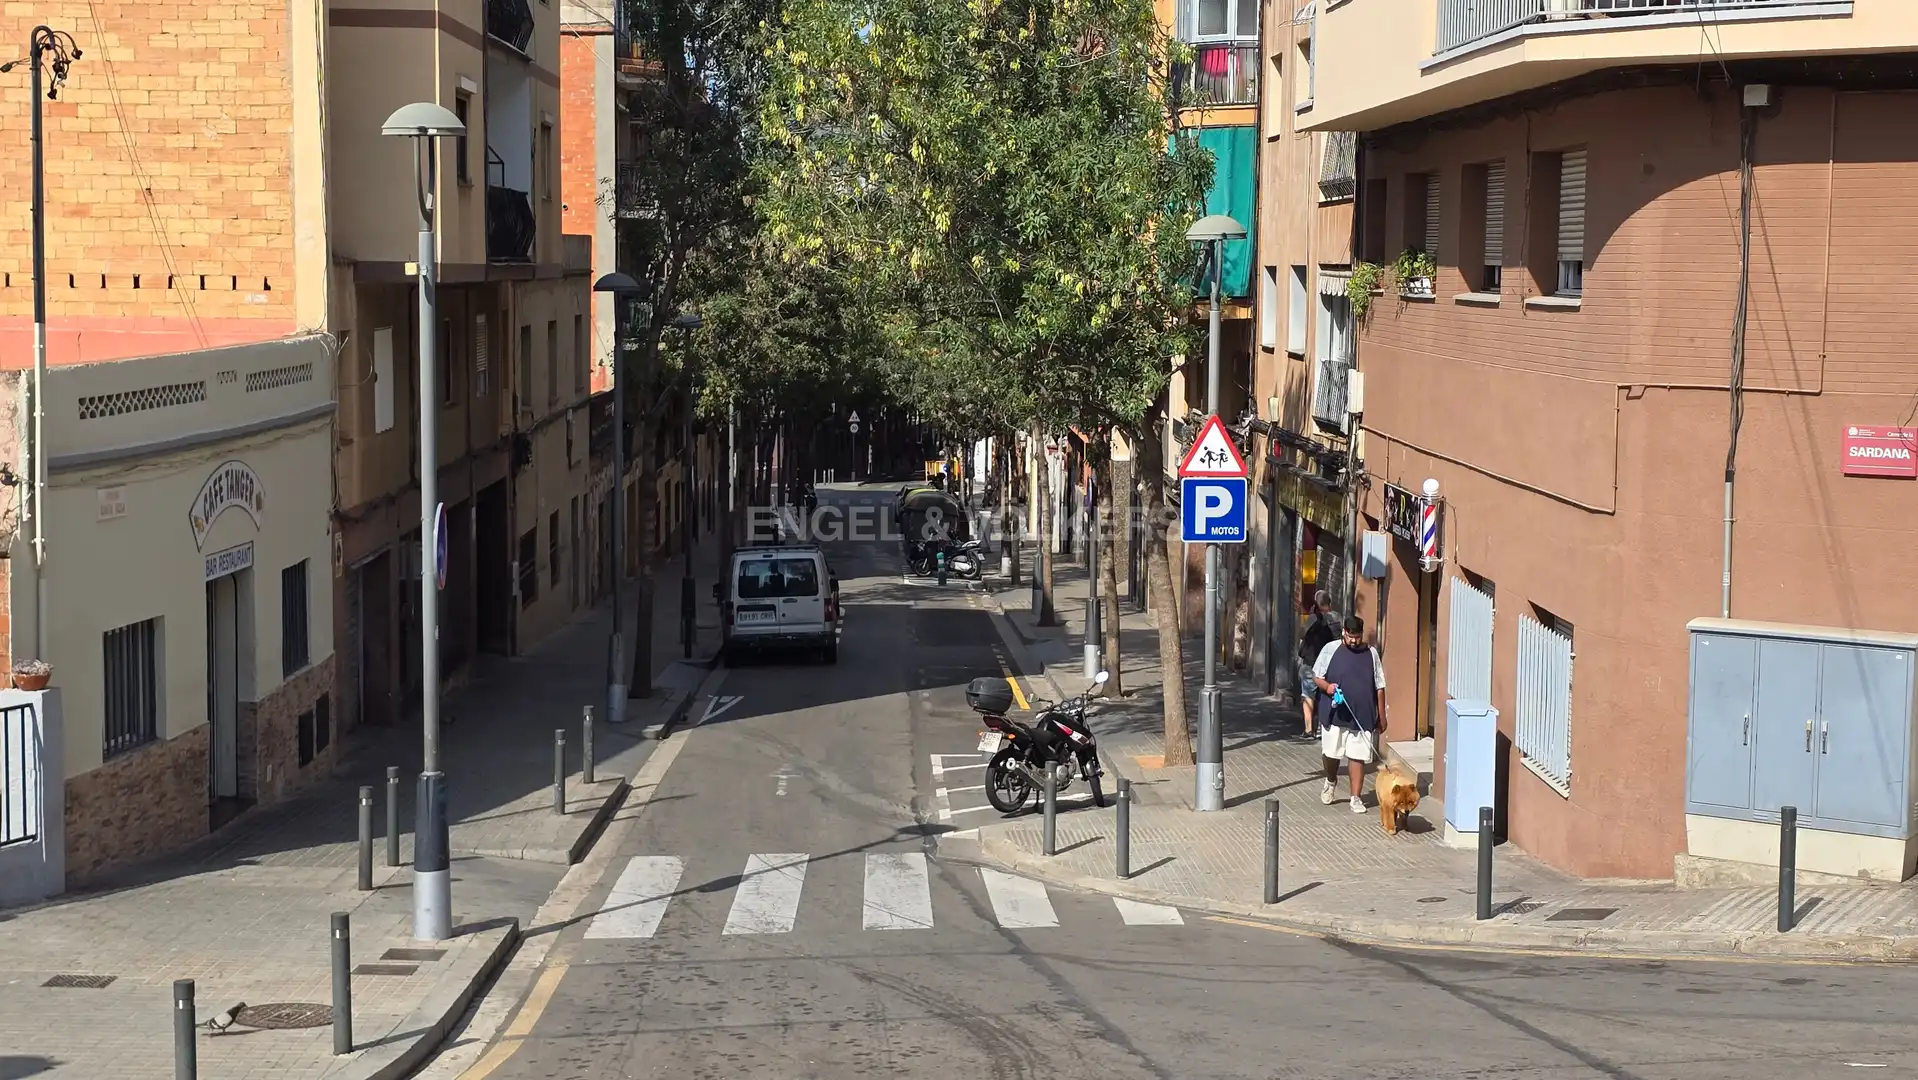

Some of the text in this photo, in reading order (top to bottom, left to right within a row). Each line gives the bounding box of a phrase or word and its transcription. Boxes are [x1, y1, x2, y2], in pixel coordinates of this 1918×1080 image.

[1849, 446, 1910, 459] SARDANA
[203, 469, 254, 525] CAFE TANGER
[1195, 486, 1233, 535] P
[1211, 526, 1239, 536] MOTOS
[205, 546, 251, 578] BAR RESTAURANT
